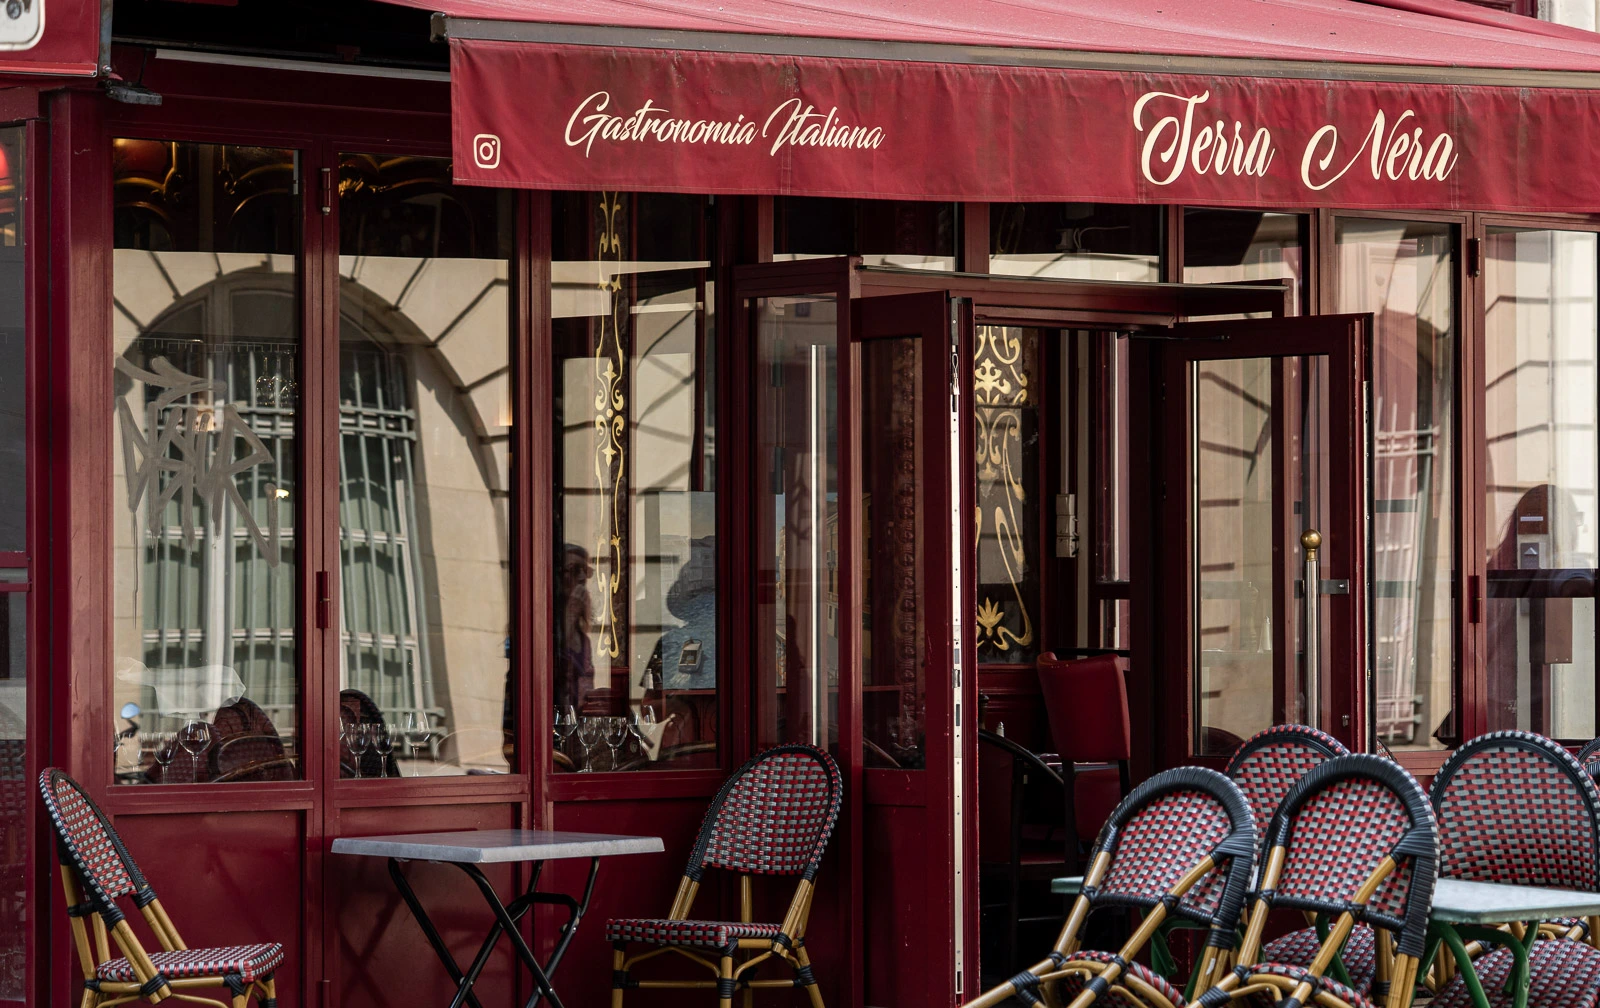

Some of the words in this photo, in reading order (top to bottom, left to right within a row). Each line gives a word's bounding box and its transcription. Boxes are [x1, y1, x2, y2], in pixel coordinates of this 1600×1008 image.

[564, 90, 760, 159] Gastronomia
[761, 97, 886, 157] Italiana
[1132, 89, 1276, 186] Terra
[1300, 108, 1459, 191] Nera
